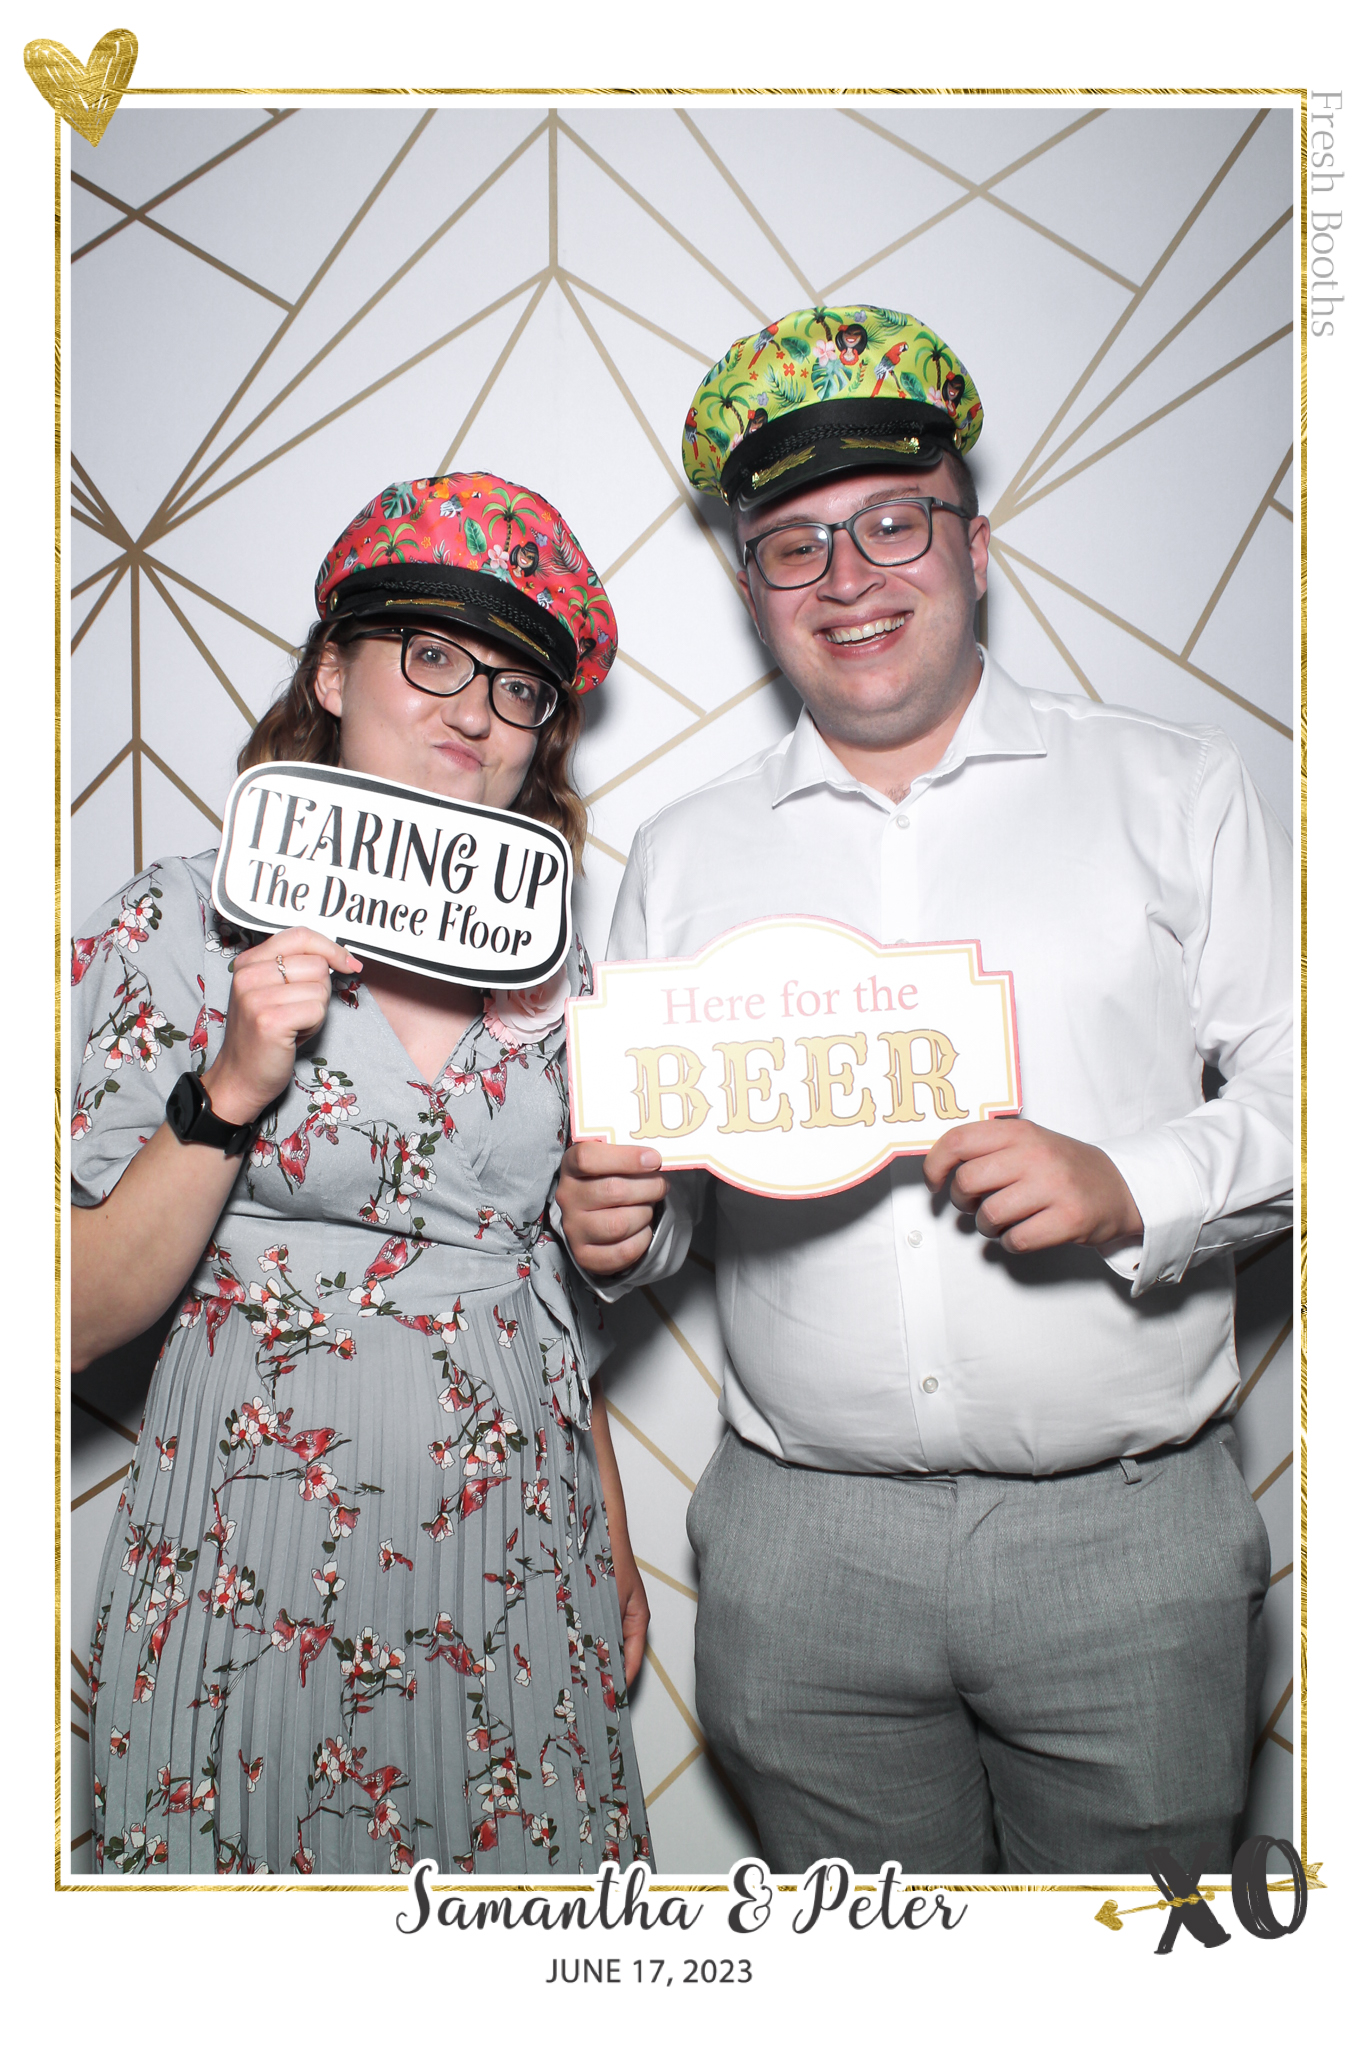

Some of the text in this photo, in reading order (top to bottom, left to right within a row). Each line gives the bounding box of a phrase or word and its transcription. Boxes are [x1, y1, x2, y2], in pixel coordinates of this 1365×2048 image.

[248, 787, 559, 909] TEARING UP
[249, 860, 532, 956] The Dance Floor
[661, 975, 919, 1025] Here for the
[624, 1029, 970, 1139] BEER
